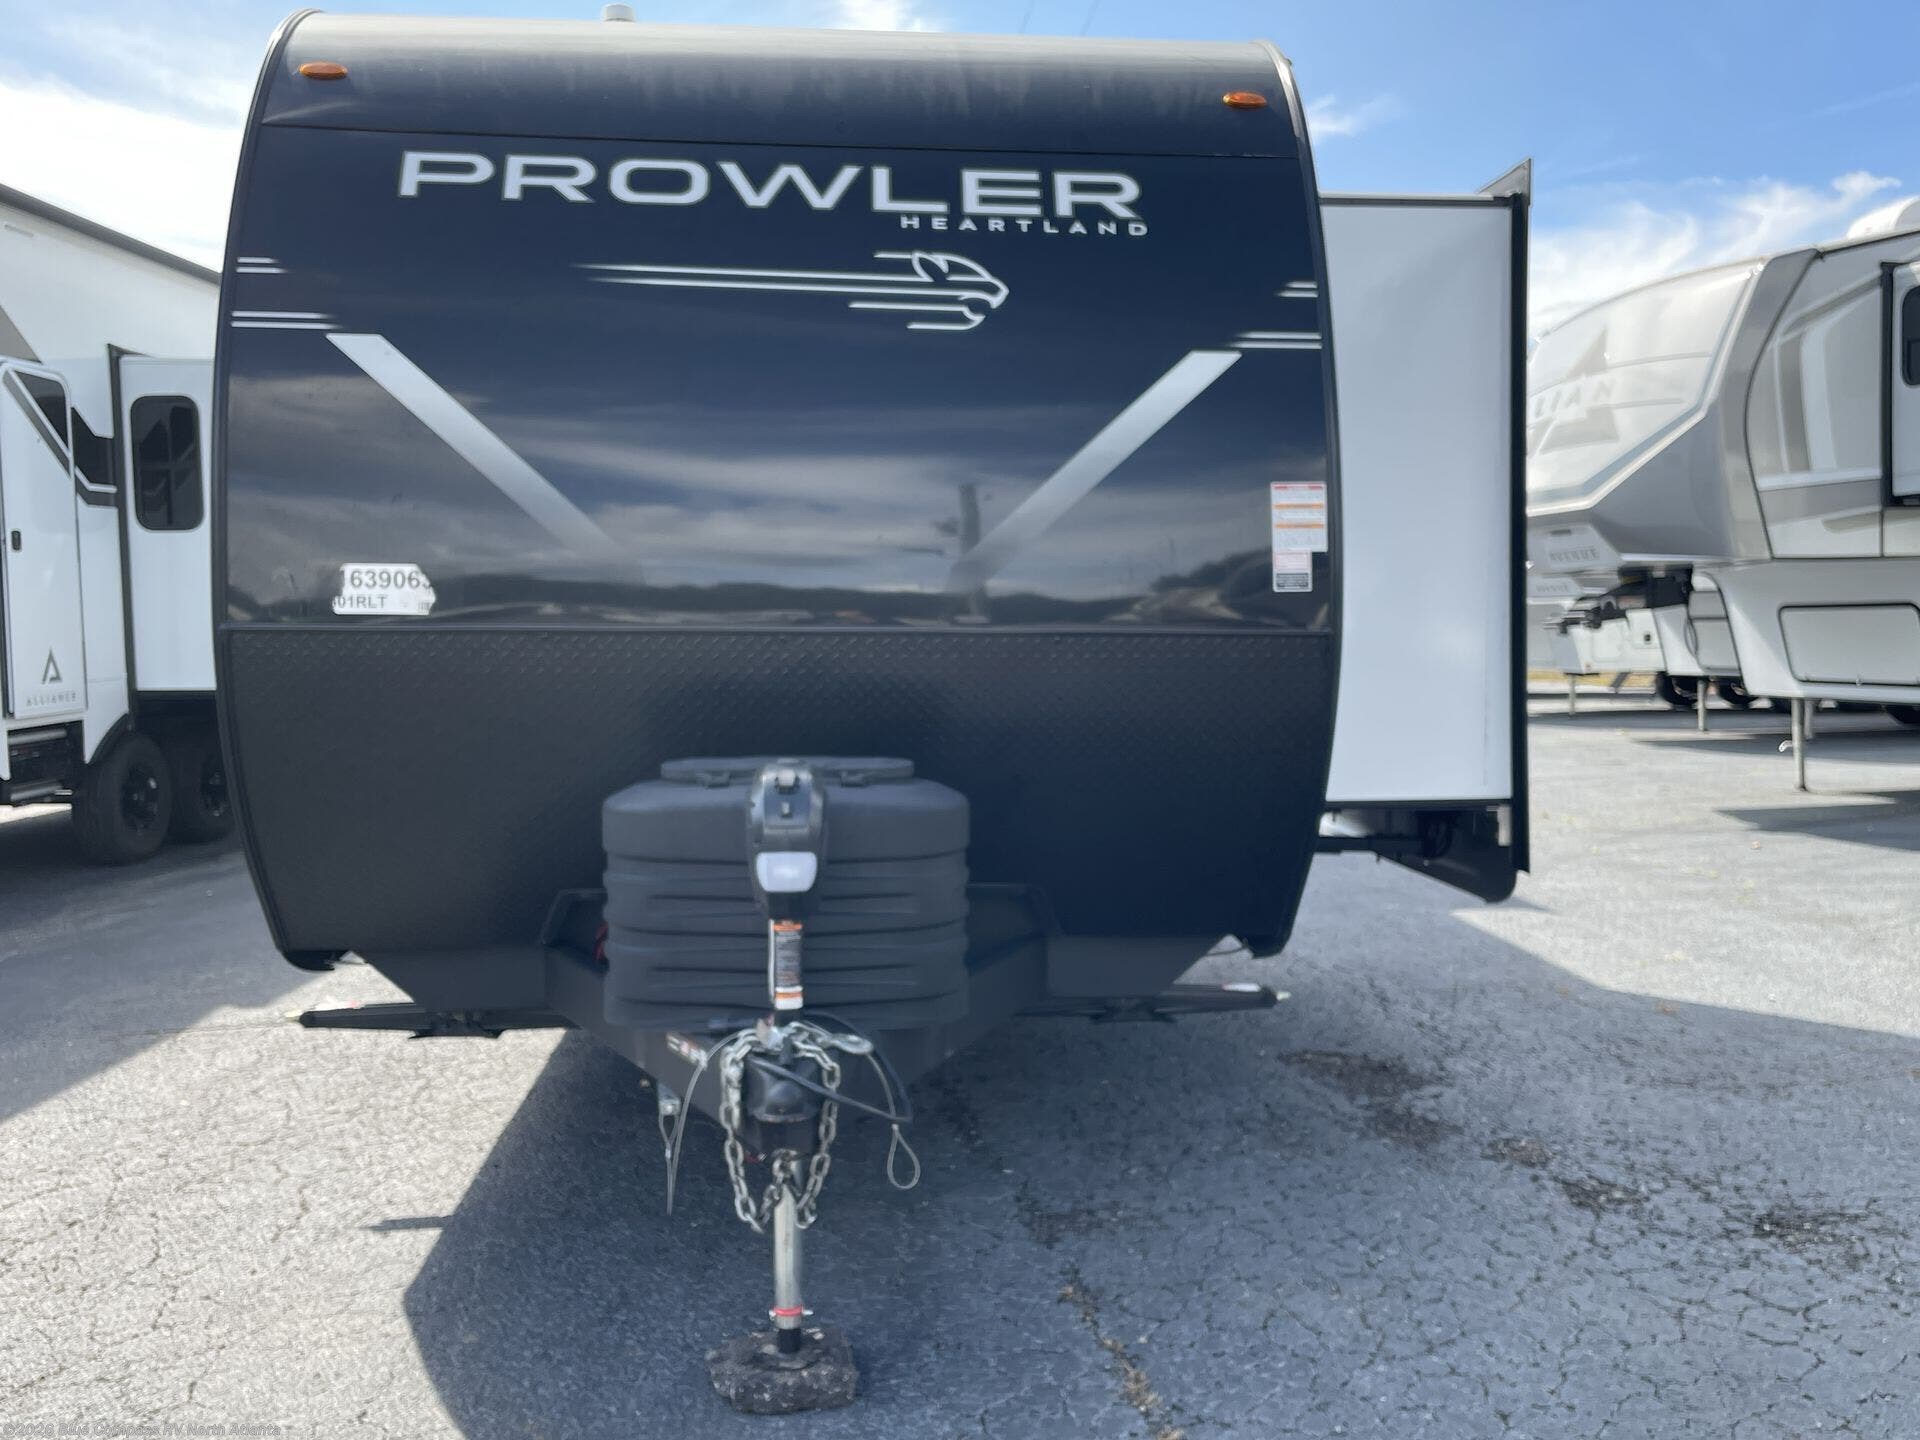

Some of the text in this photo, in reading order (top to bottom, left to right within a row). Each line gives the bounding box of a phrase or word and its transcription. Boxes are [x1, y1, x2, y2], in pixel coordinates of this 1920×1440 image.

[398, 150, 1142, 219] PROWLER
[900, 215, 1148, 236] HEARTLAND
[333, 594, 387, 609] 01RLT
